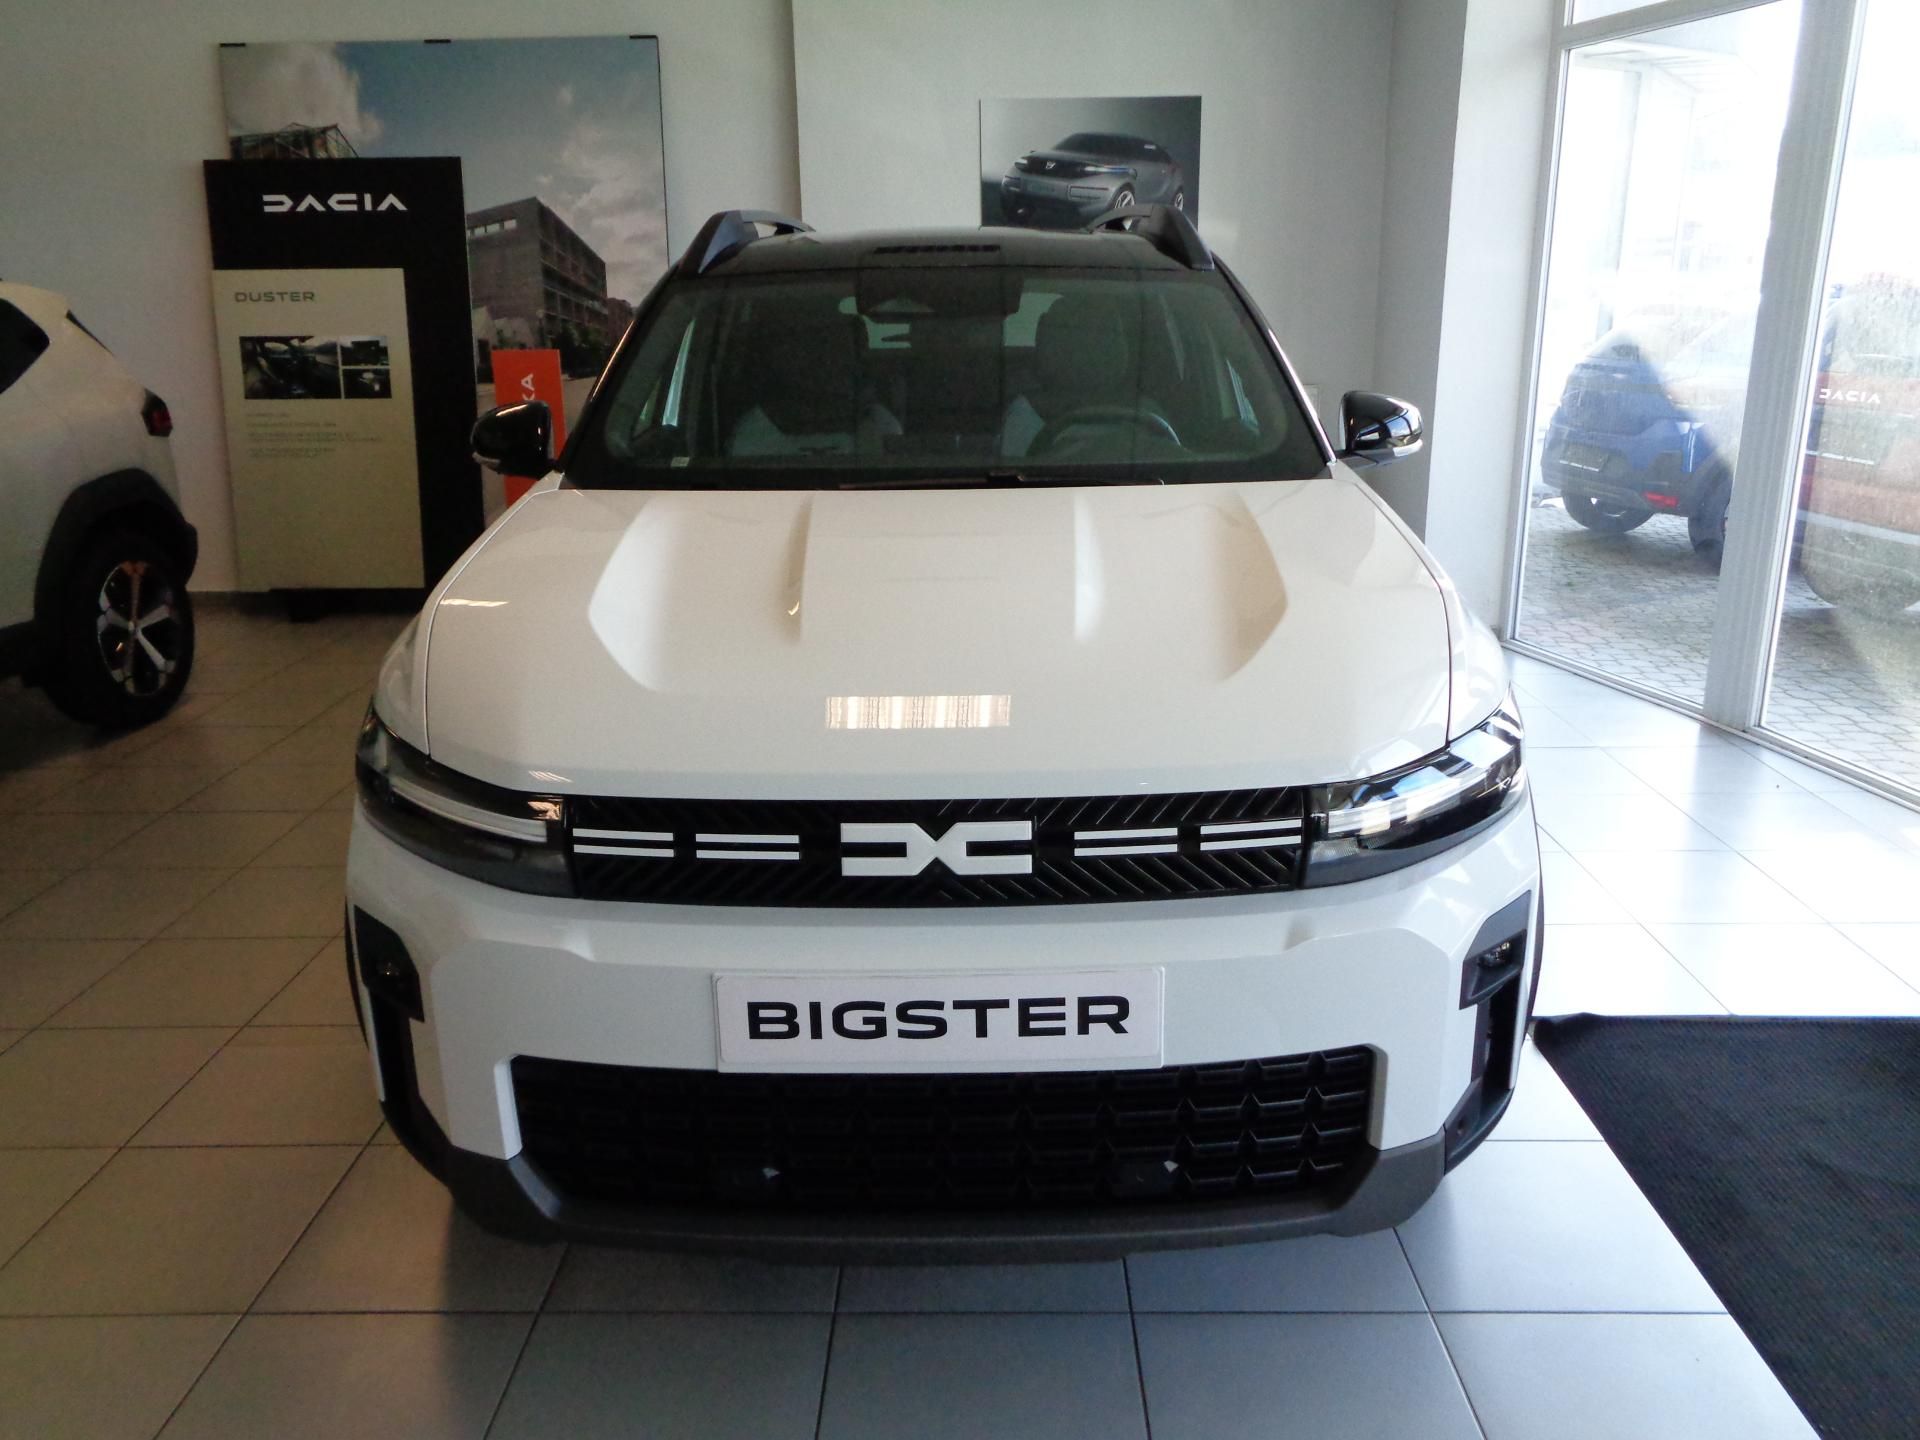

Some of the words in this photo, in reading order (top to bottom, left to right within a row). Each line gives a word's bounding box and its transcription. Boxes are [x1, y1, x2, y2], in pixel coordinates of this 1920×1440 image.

[262, 193, 408, 213] DACIA
[234, 291, 316, 303] DUSTER
[1819, 388, 1881, 404] DACIA
[746, 995, 1130, 1040] BIGSTER
